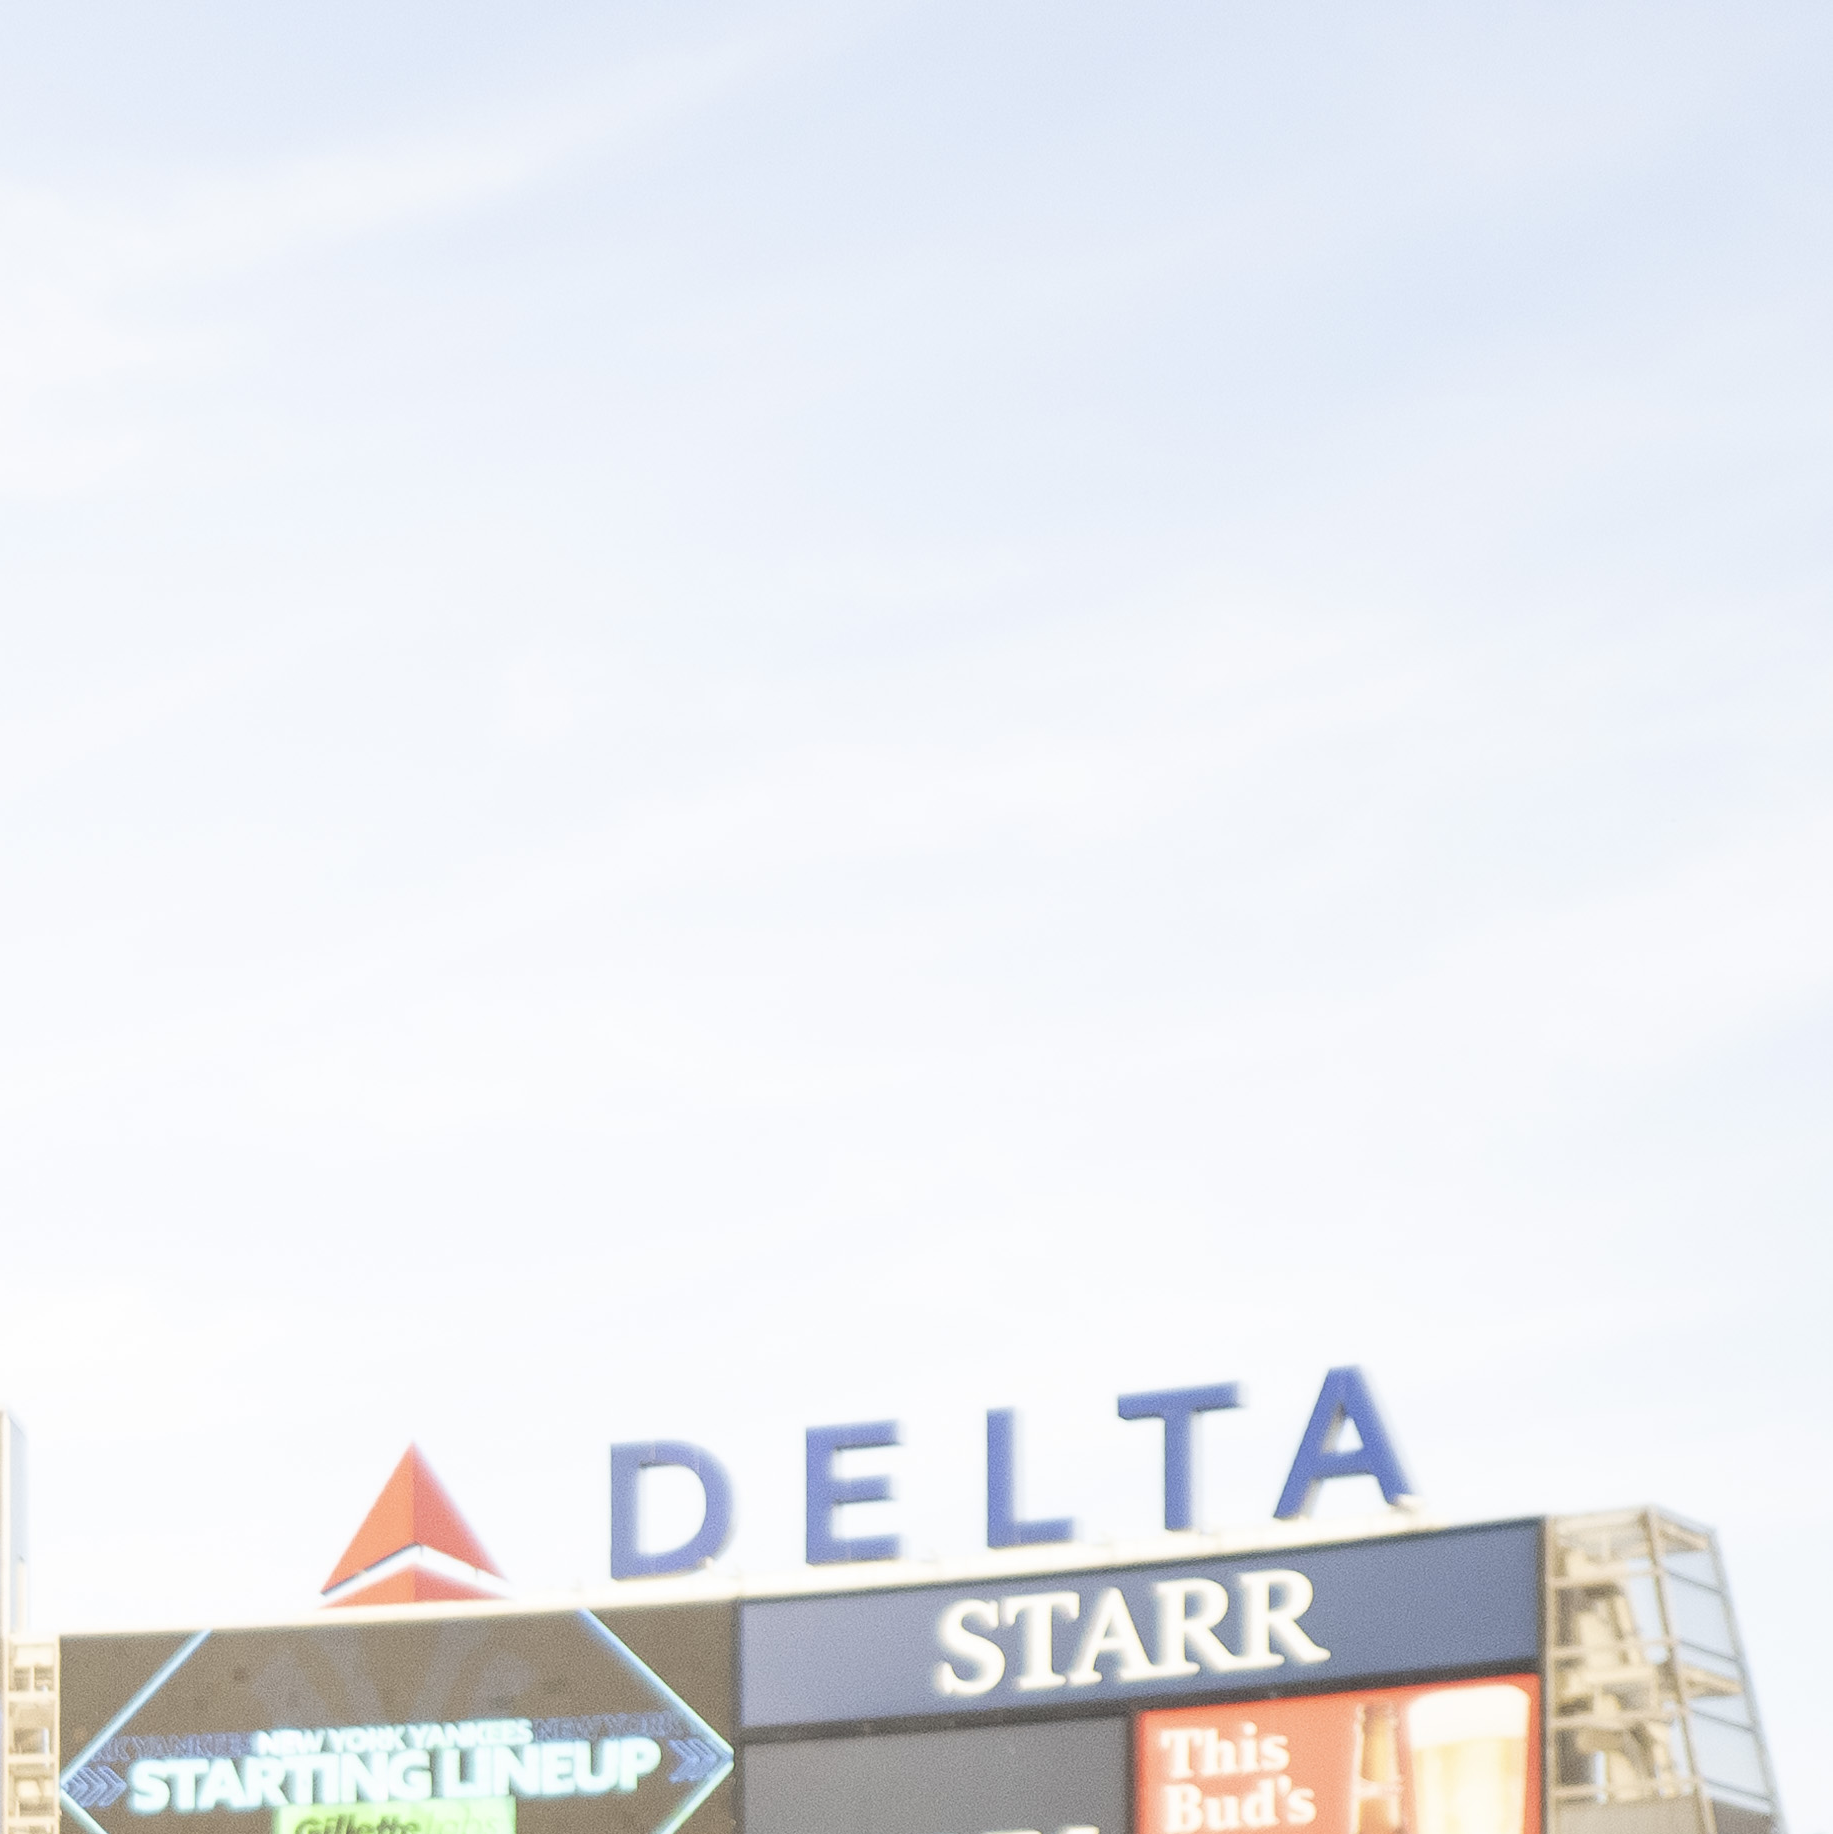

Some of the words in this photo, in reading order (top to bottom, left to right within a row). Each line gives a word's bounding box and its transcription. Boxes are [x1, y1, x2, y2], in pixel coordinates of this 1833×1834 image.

[609, 1365, 1417, 1581] DELTA
[936, 1568, 1331, 1698] STARR
[258, 1727, 326, 1756] NEW
[329, 1724, 408, 1752] YORK
[408, 1718, 534, 1749] YANKEES
[1160, 1723, 1290, 1780] This
[128, 1755, 435, 1815] STARTING
[441, 1737, 663, 1802] LINEUP
[1164, 1778, 1317, 1834] Bud's
